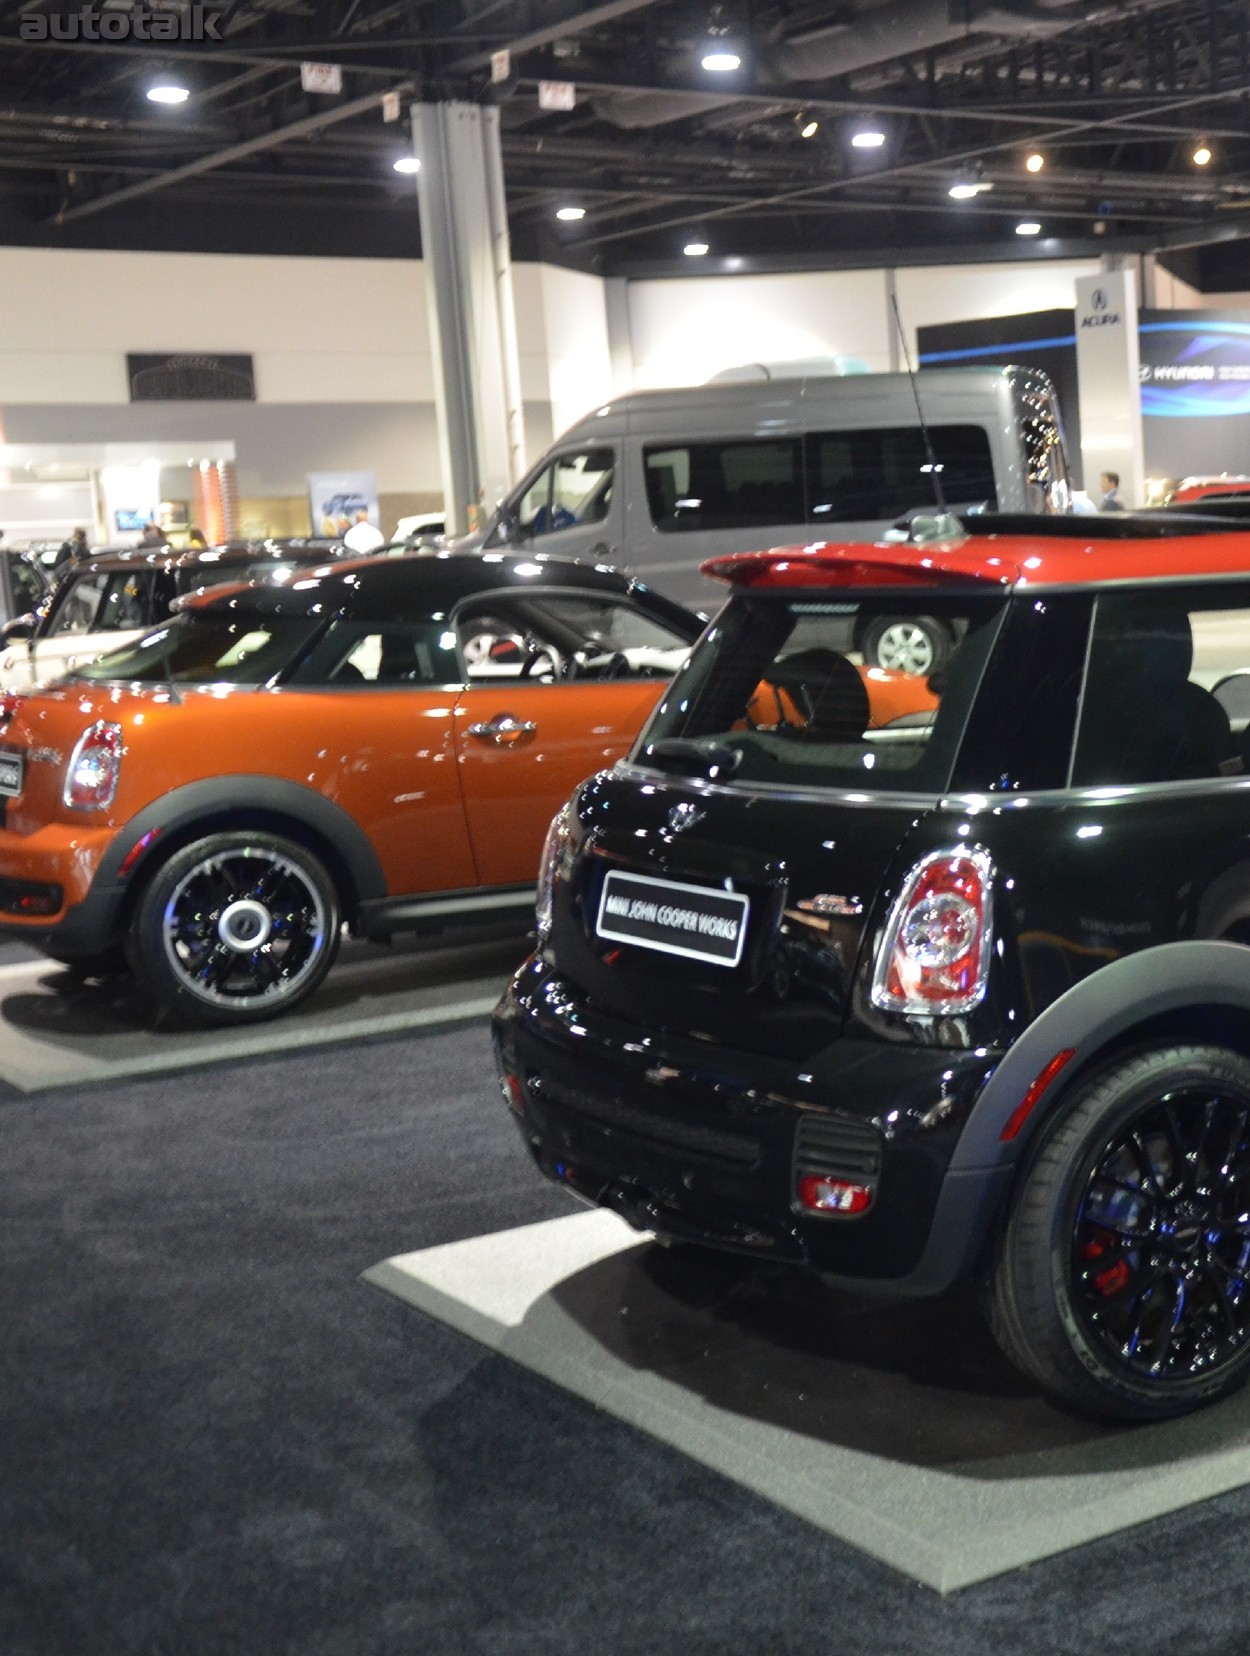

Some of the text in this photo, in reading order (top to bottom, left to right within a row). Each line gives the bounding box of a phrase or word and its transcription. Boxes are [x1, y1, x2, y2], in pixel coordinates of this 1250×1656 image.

[1081, 314, 1120, 328] ACURA
[1153, 365, 1215, 380] HYUNDAI
[605, 894, 738, 941] MINI JOHN COOPER WORKS
